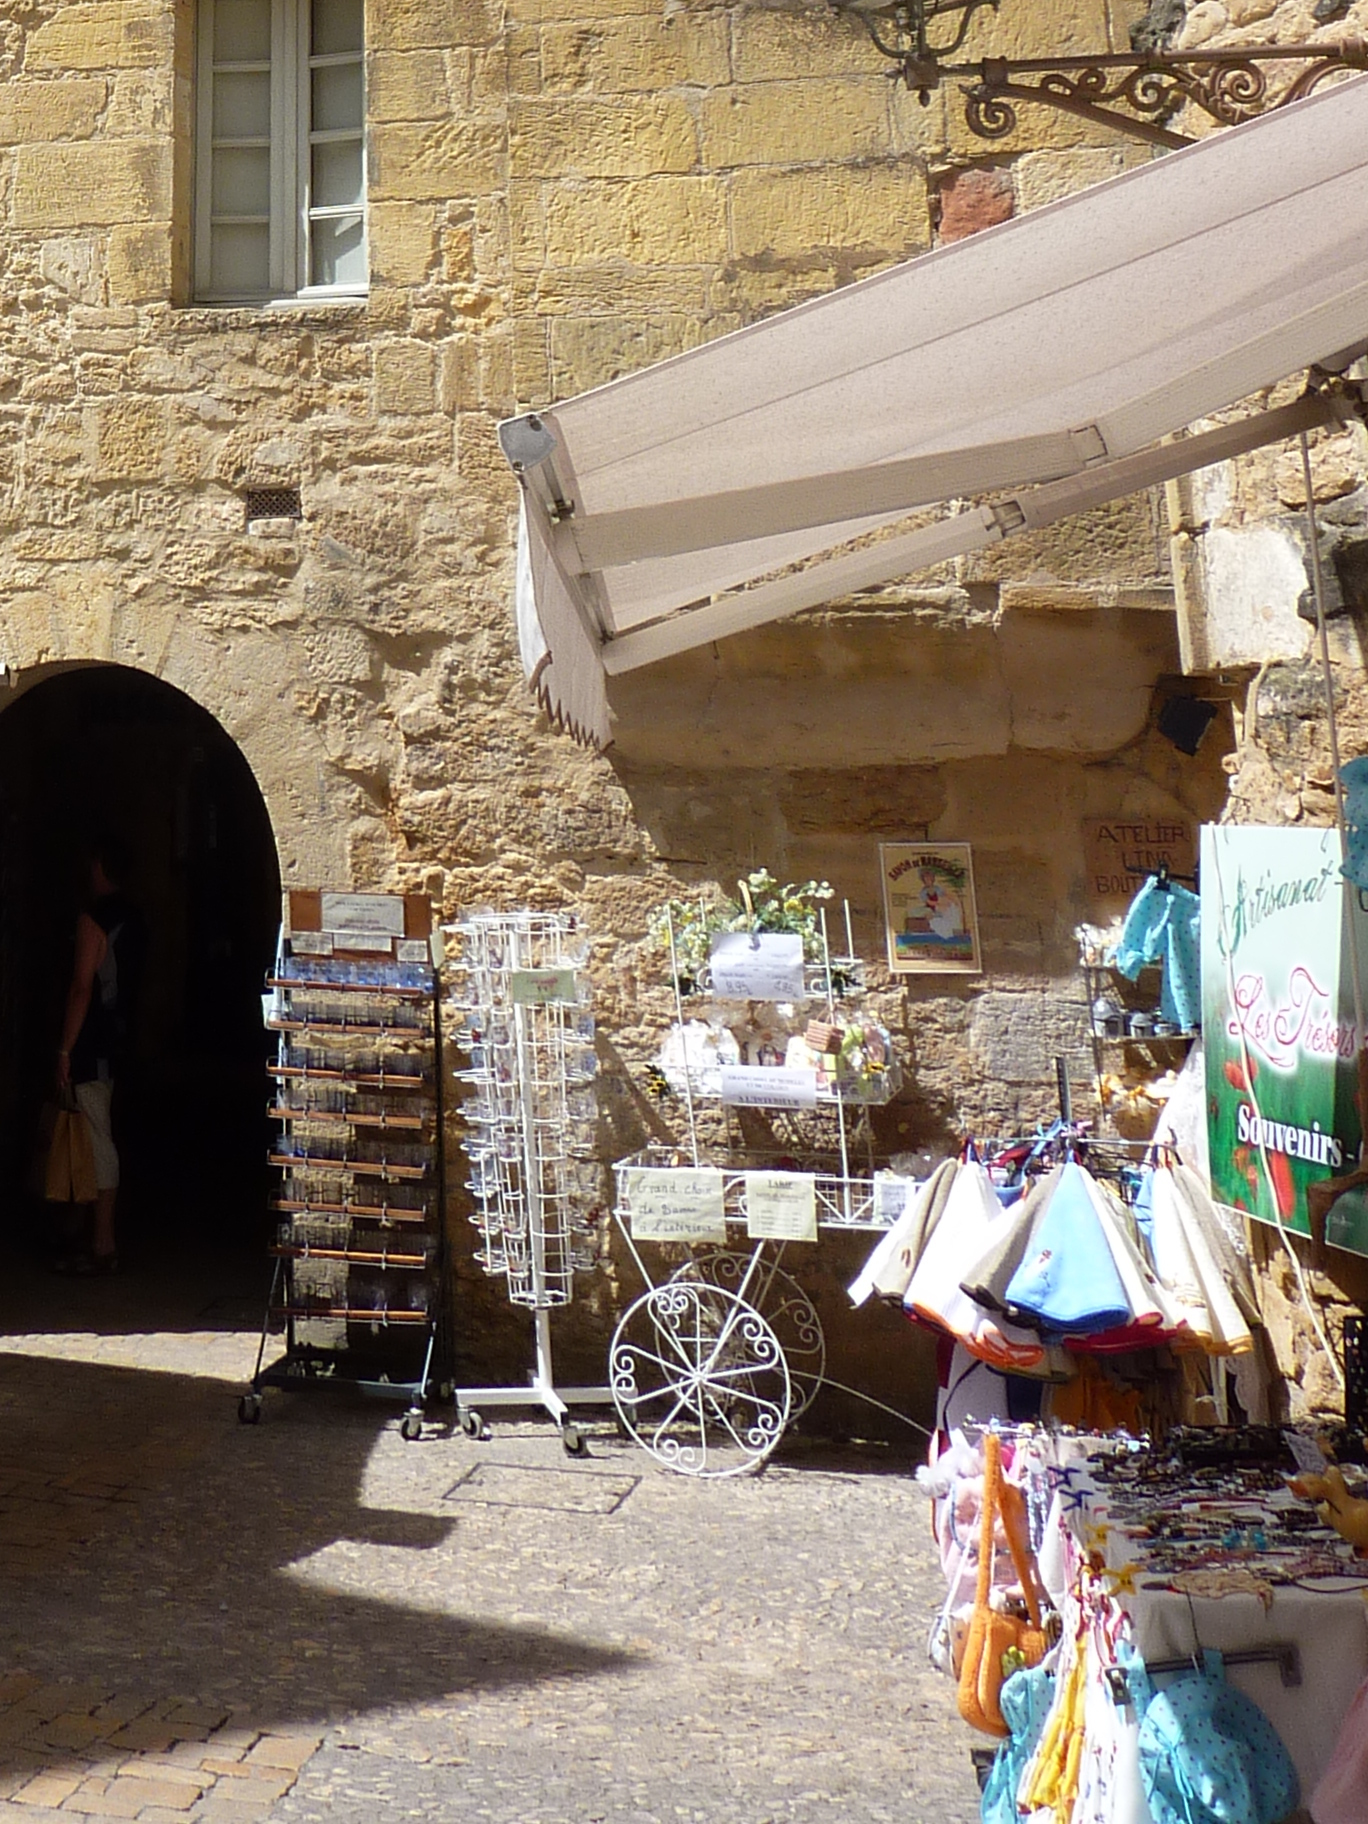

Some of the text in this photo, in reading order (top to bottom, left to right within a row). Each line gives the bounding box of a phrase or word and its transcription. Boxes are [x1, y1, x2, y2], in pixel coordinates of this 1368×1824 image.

[1096, 822, 1191, 844] ATELIER
[1095, 875, 1144, 894] BOUT
[1218, 860, 1334, 966] Artisanat
[1228, 967, 1356, 1068] Les Trésors
[1237, 1103, 1343, 1167] Souvenirs
[636, 1176, 678, 1194] Grand
[638, 1202, 653, 1215] de
